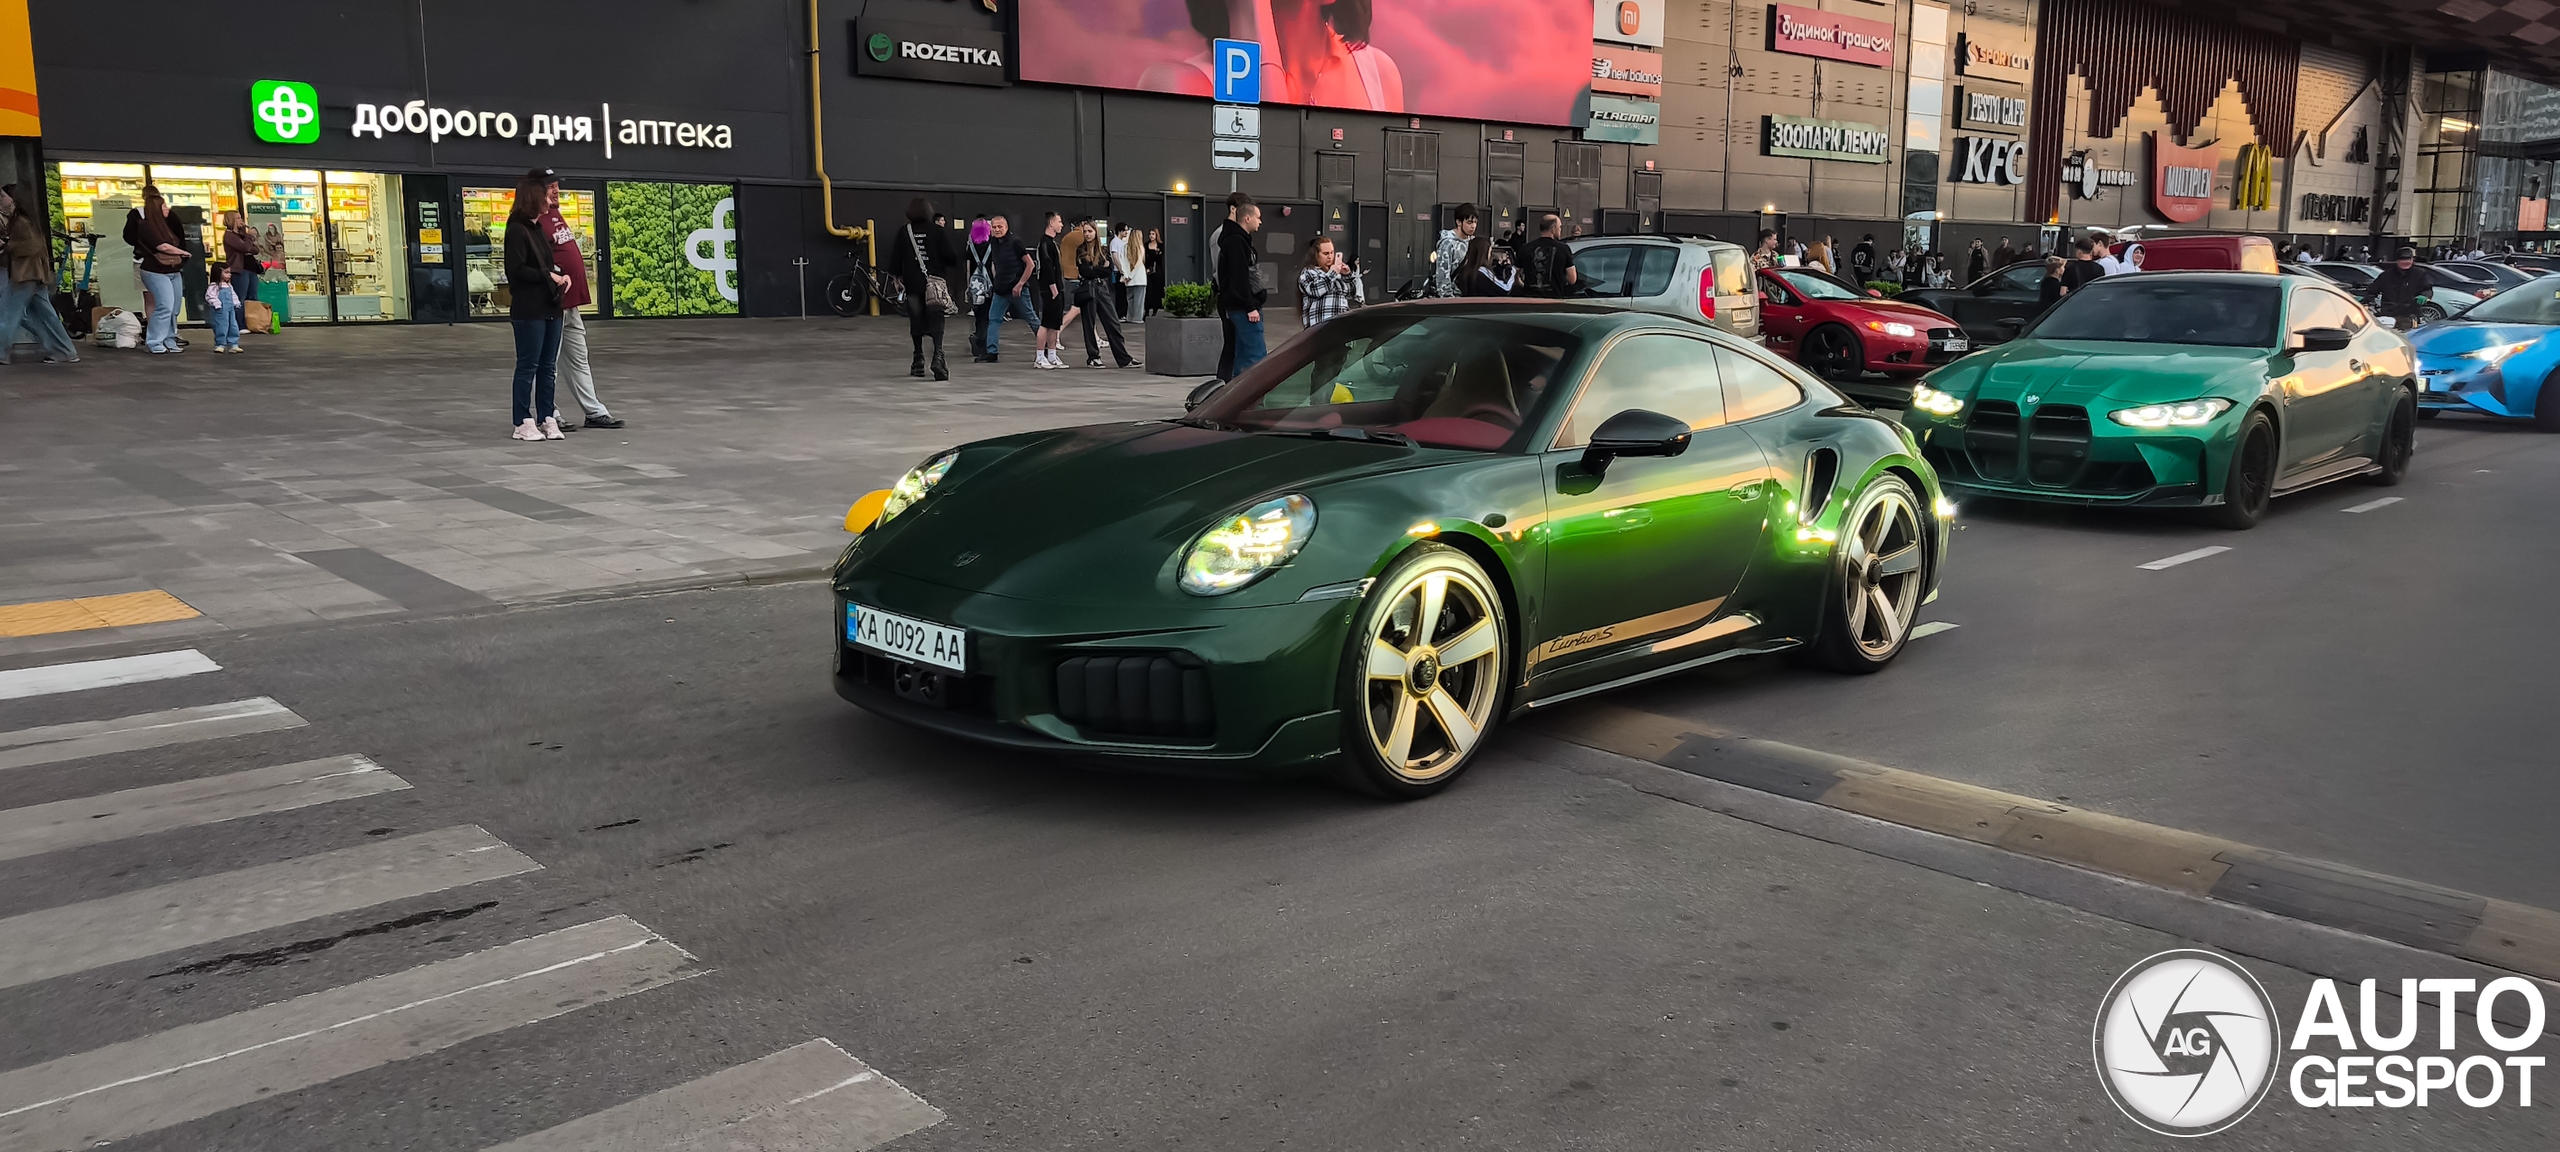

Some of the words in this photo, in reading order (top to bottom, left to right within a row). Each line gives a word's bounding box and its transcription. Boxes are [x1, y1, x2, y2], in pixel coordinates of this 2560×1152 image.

[1782, 14, 1835, 41] будинок
[901, 41, 1003, 66] ROZETKA
[1226, 47, 1251, 95] P
[1611, 69, 1628, 80] new
[1629, 69, 1663, 84] balance
[352, 99, 518, 143] доброго
[528, 113, 593, 146] дня
[618, 118, 733, 149] аптека
[1593, 110, 1657, 124] FLAGMAN
[1969, 92, 2001, 124] PESTO
[2002, 97, 2026, 127] CAFE
[1775, 123, 1841, 151] ЗООПАРК
[1842, 129, 1888, 155] ЛЕМУР
[1962, 136, 2027, 185] KFC
[2165, 165, 2213, 198] MULTIPLEX
[856, 609, 879, 643] KA
[884, 618, 925, 656] 0092
[933, 631, 961, 664] AA
[1597, 626, 1616, 641] S
